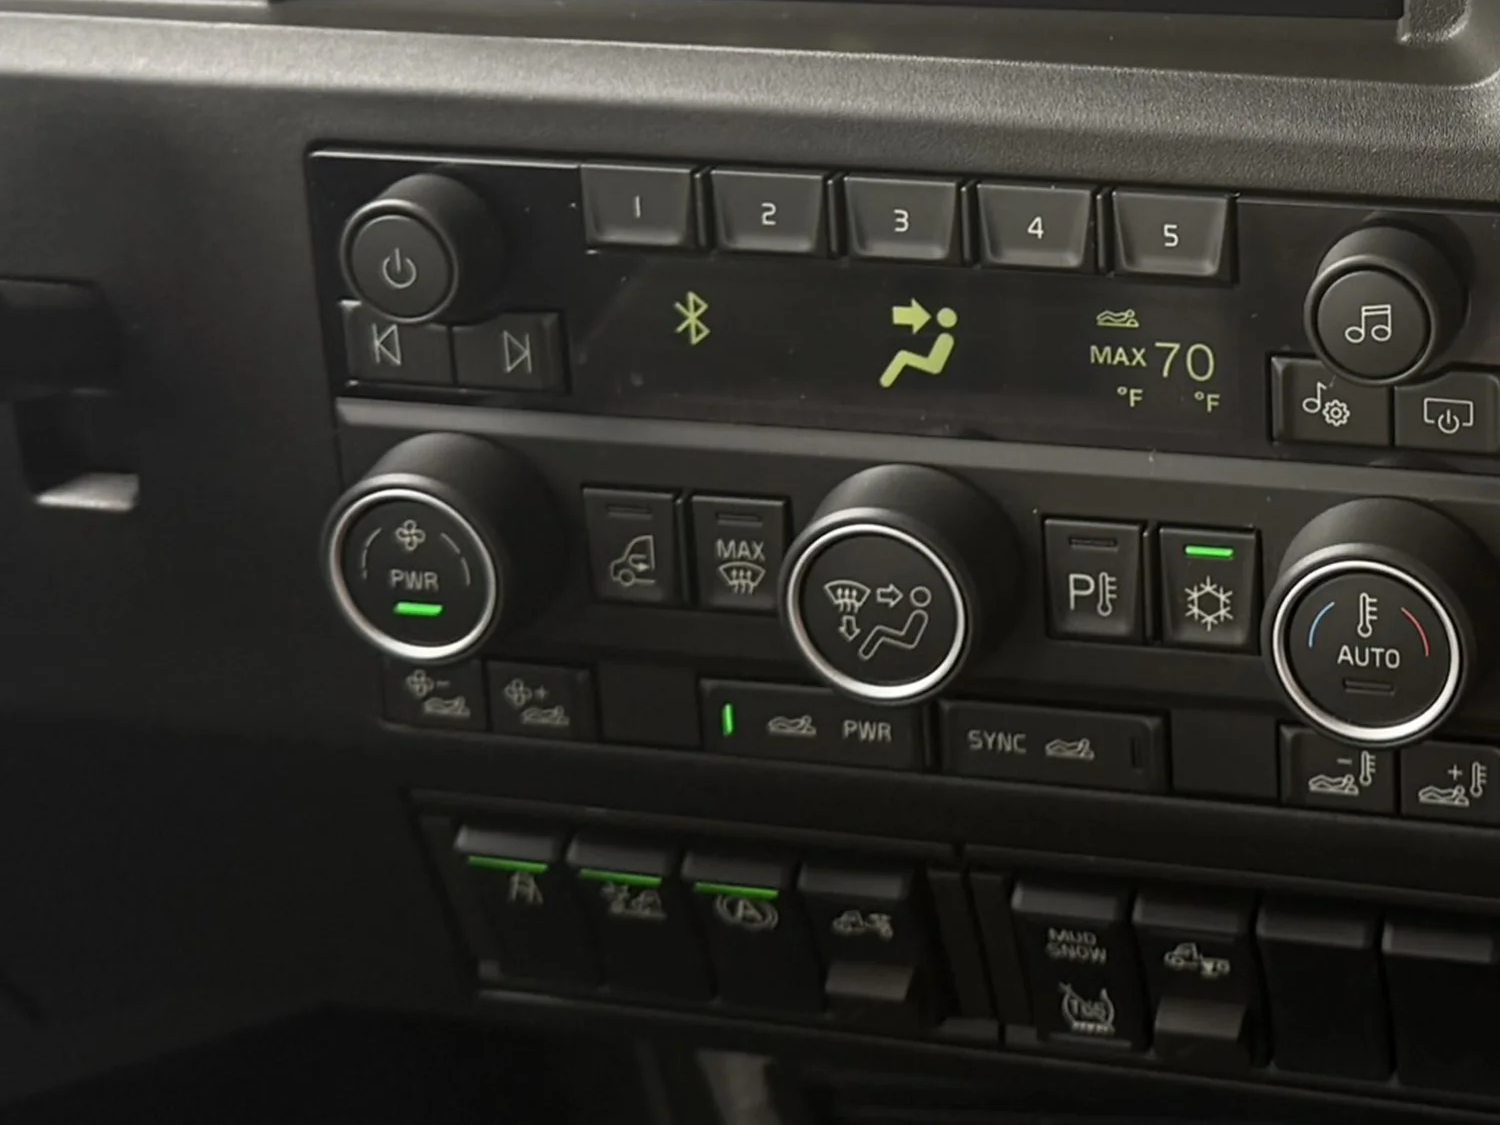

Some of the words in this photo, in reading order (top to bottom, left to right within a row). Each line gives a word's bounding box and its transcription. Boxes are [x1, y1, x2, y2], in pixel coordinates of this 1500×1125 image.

[762, 203, 776, 225] 2
[894, 209, 908, 232] 3
[1028, 217, 1043, 238] 4
[1164, 224, 1178, 246] 5
[1091, 345, 1146, 366] MAX
[1155, 342, 1214, 381] 70
[717, 539, 765, 561] MAX
[391, 569, 438, 589] PWR
[1069, 574, 1095, 609] P
[1338, 645, 1400, 668] AUTO
[844, 720, 891, 741] PWR
[968, 730, 1026, 753] SYNC
[1047, 927, 1097, 946] MUD
[1045, 942, 1107, 965] SNOW
